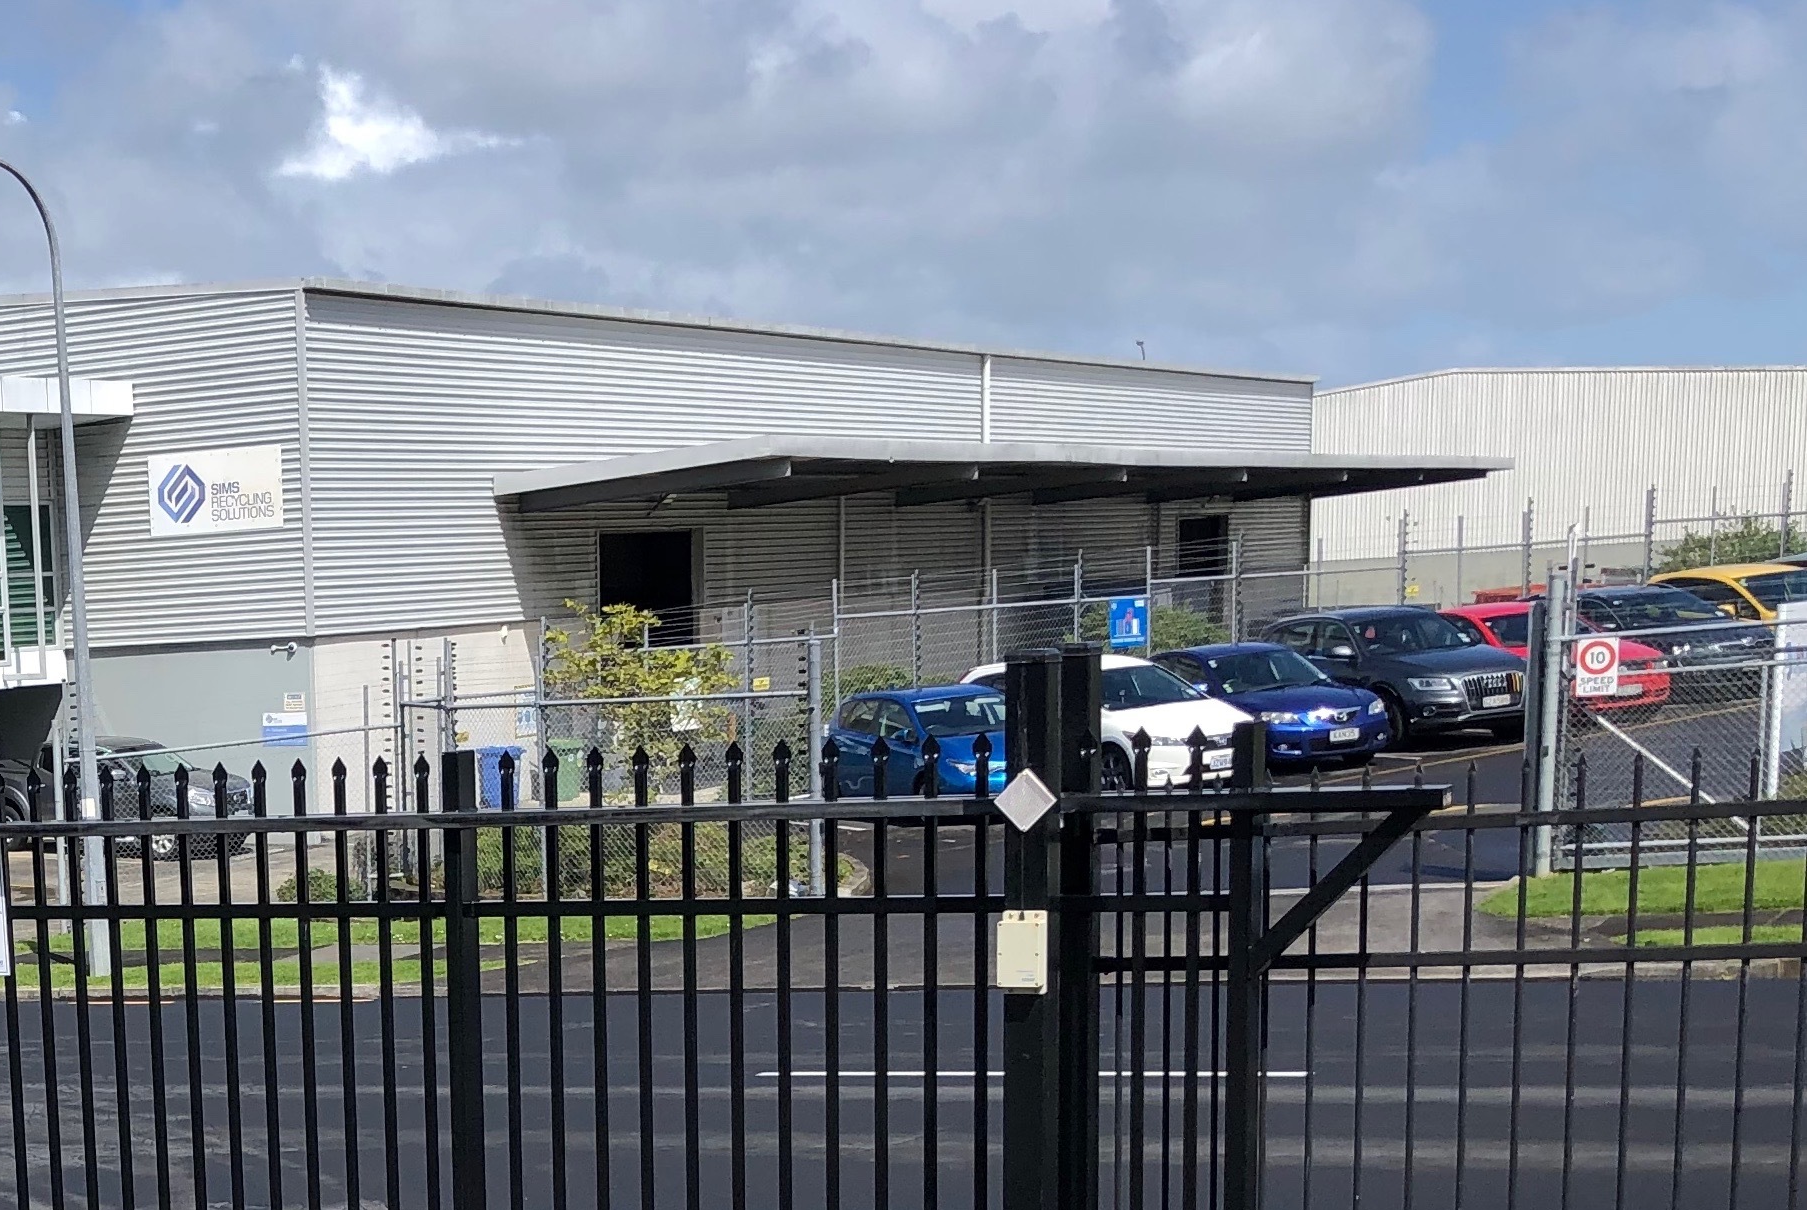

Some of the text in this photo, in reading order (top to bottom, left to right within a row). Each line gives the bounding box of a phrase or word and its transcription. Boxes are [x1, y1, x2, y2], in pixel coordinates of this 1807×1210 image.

[210, 481, 240, 496] SIMS
[211, 491, 272, 509] RECYCLING
[211, 504, 275, 522] SOLUTIONS
[1590, 651, 1606, 665] 10
[1580, 676, 1615, 686] SPEED
[1582, 685, 1610, 694] LIMIT
